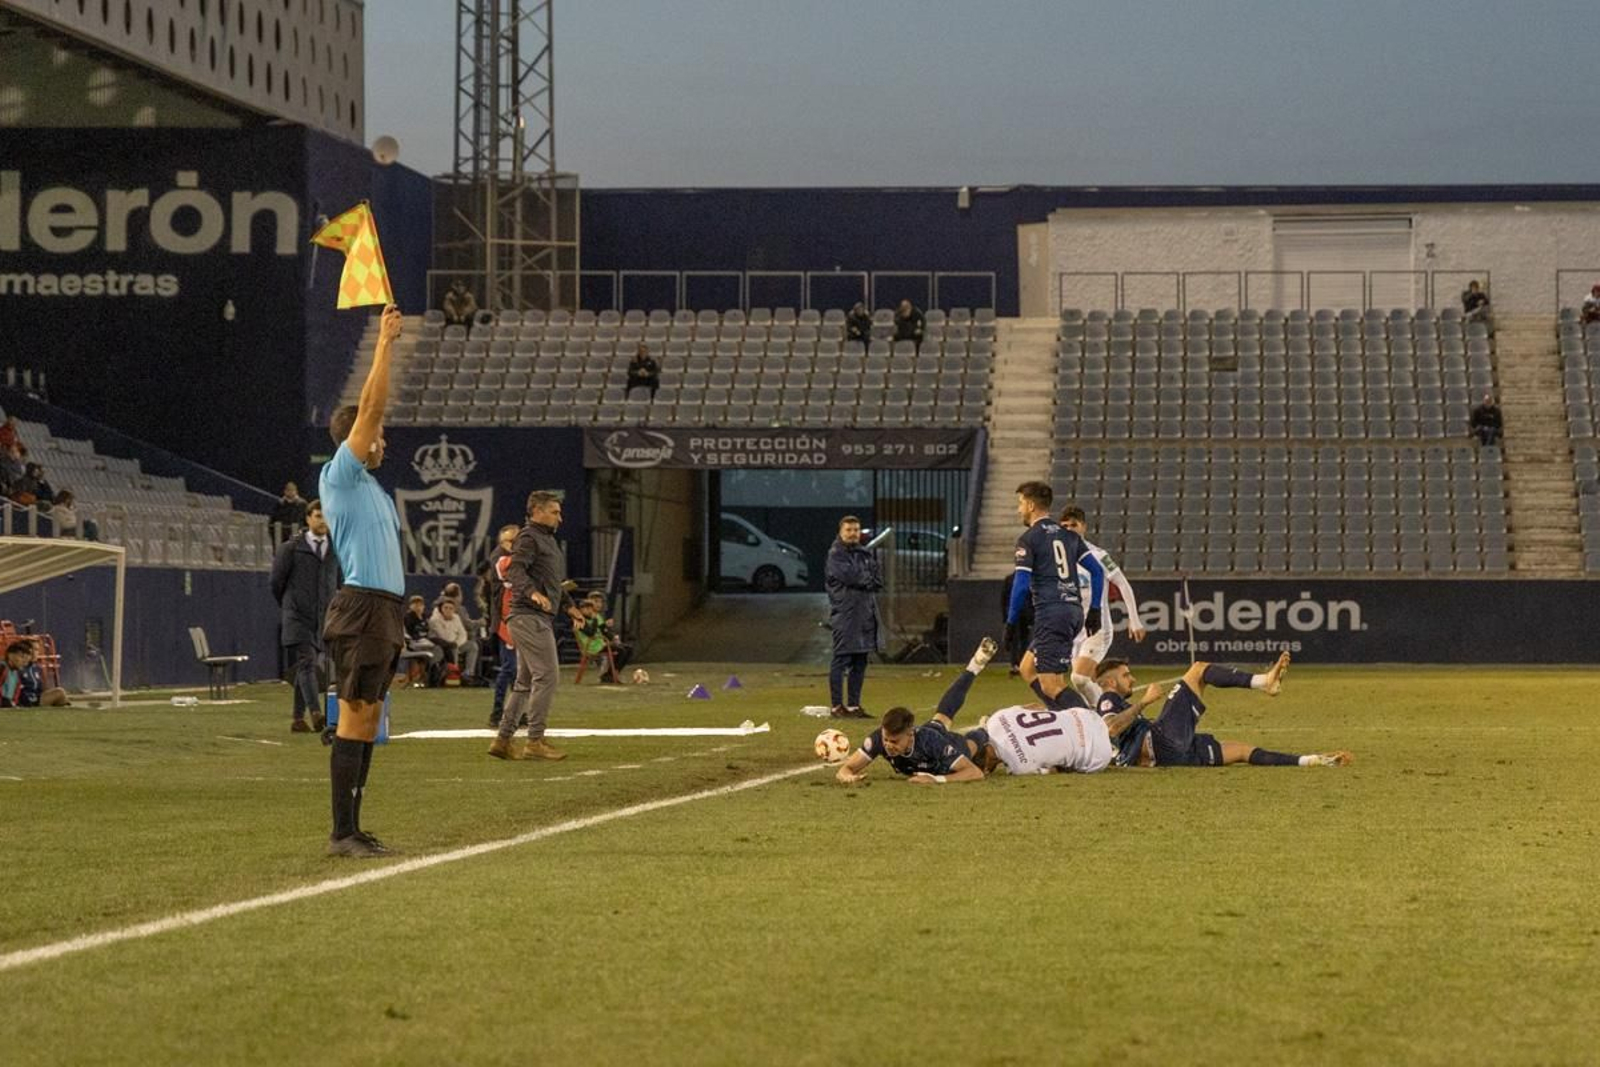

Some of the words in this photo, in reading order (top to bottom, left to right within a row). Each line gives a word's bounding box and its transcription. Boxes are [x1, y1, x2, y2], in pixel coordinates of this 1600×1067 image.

[0, 270, 179, 297] maestras
[689, 434, 827, 450] PROTECCIÓN
[841, 444, 876, 456] 953
[883, 444, 915, 456] 271
[923, 444, 959, 456] 802
[689, 453, 703, 465] Y
[706, 453, 827, 465] SEGURIDAD
[1052, 539, 1069, 580] 9
[1155, 638, 1209, 652] obras
[1214, 638, 1302, 652] maestras
[1016, 711, 1064, 747] 16
